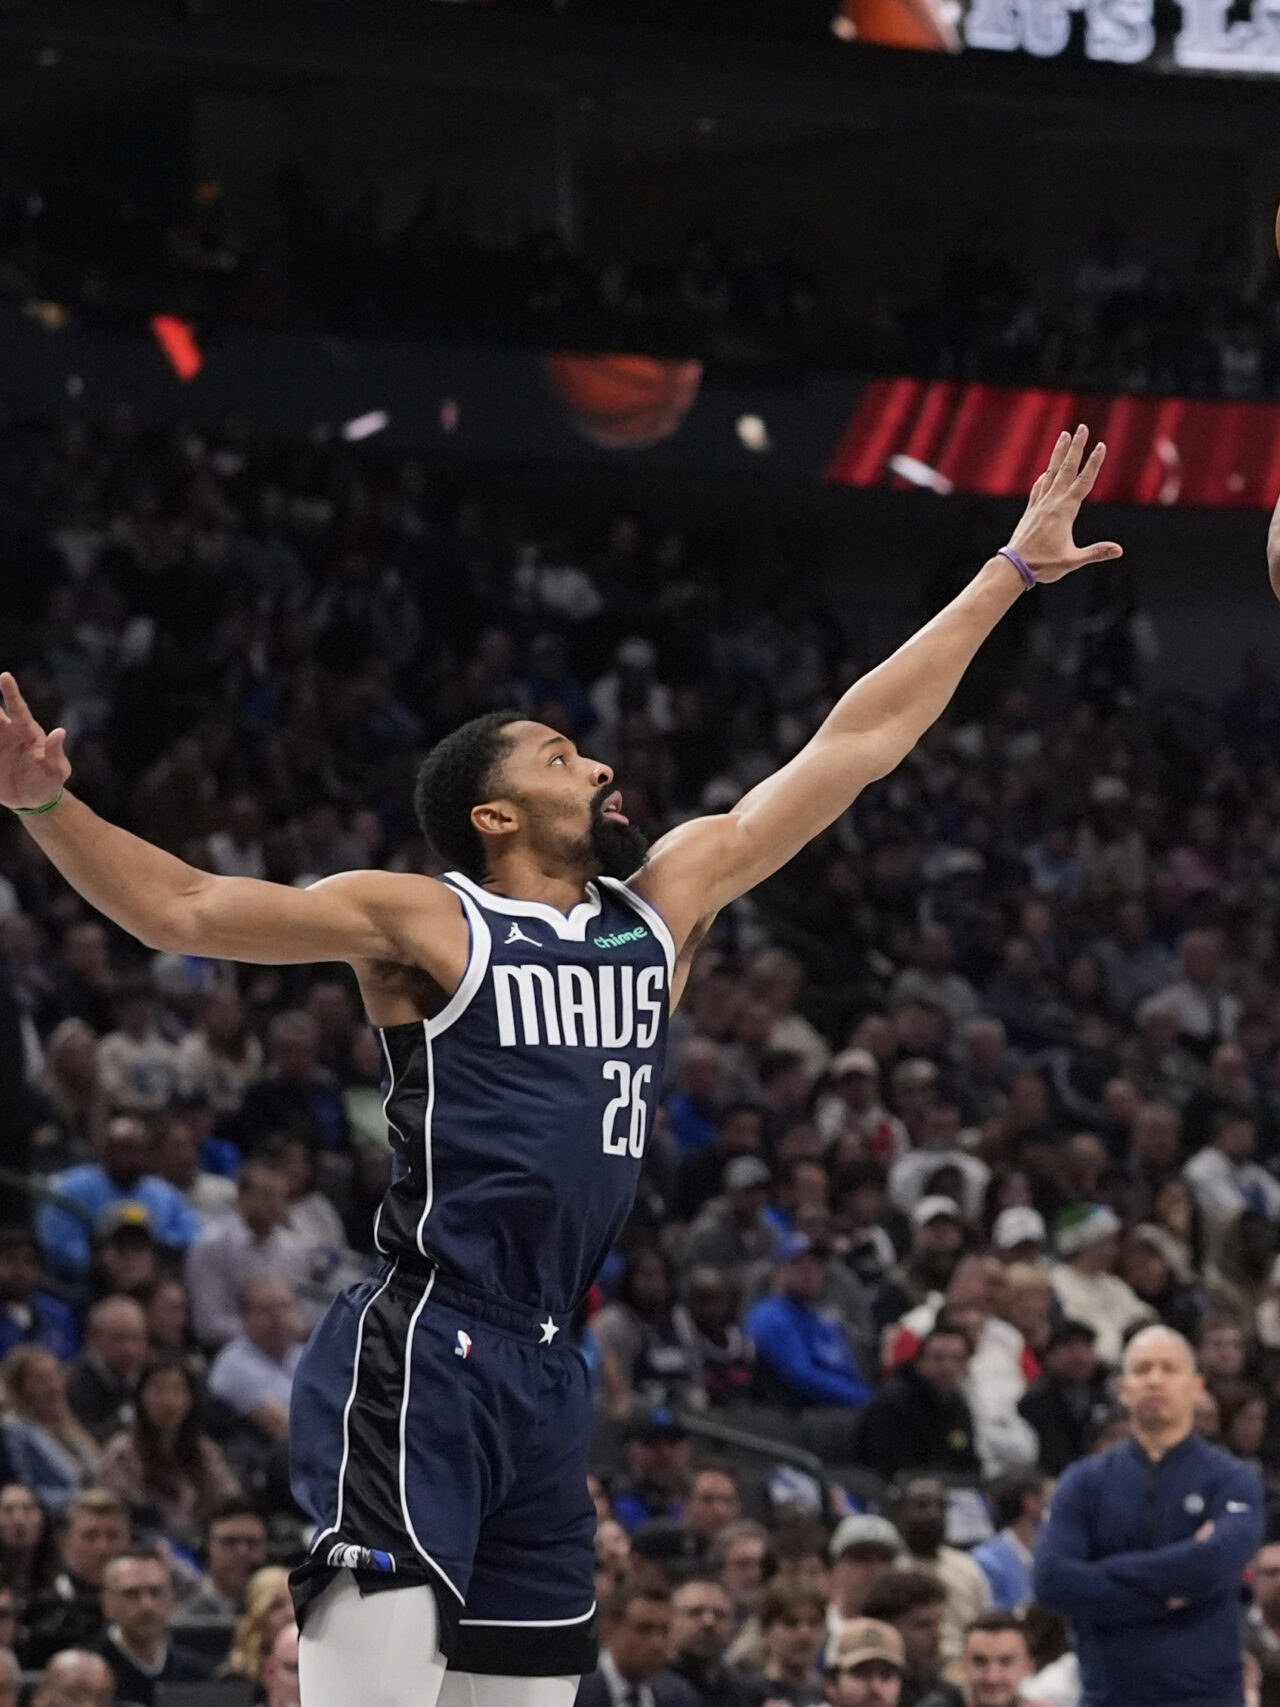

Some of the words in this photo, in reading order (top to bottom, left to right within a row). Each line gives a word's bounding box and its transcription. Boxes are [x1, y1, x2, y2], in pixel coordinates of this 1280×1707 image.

[963, 0, 1156, 64] Its
[593, 926, 648, 949] chime
[492, 964, 665, 1048] MAVS
[602, 1060, 653, 1159] 26
